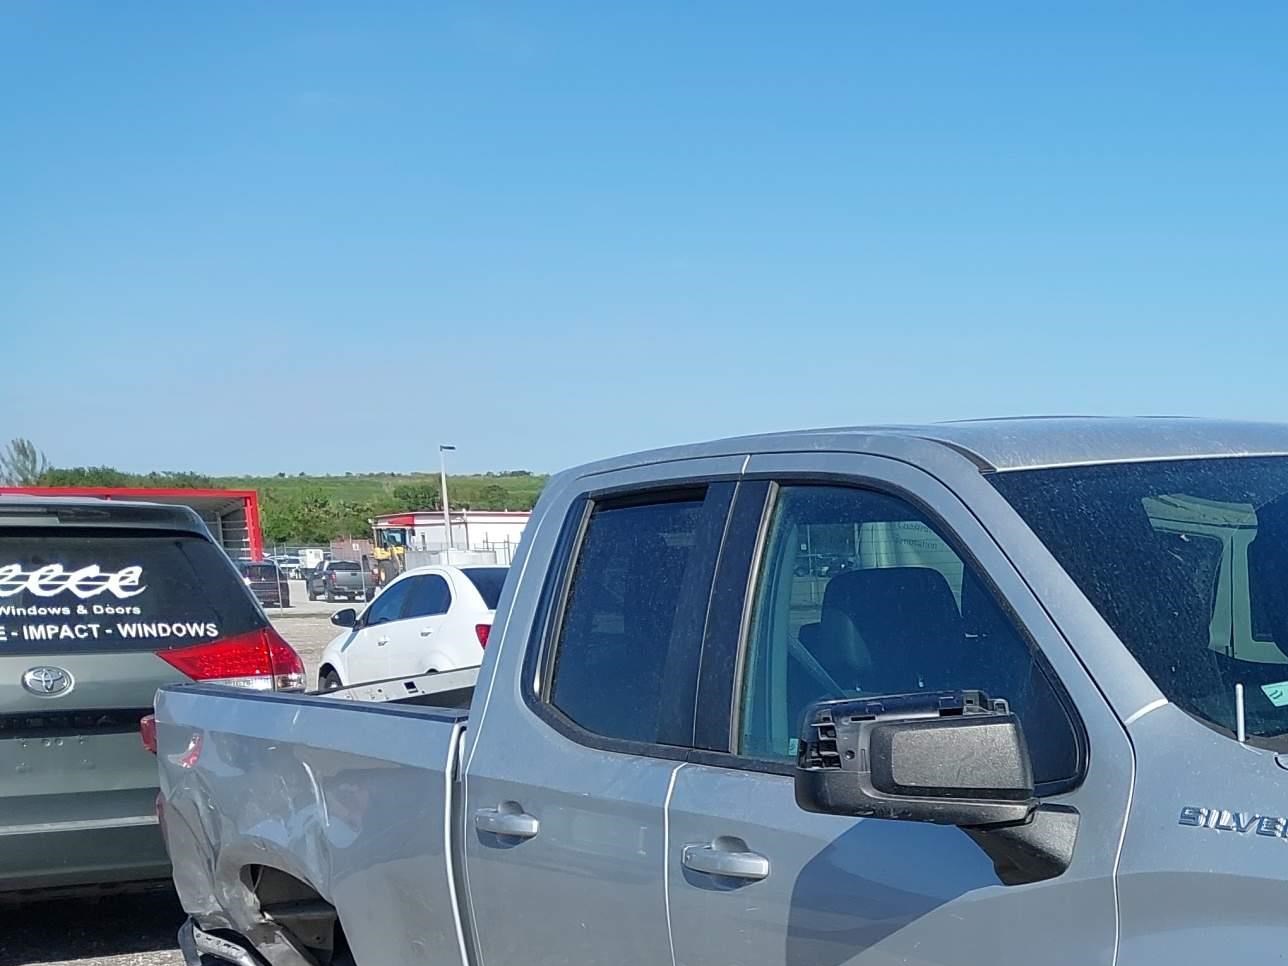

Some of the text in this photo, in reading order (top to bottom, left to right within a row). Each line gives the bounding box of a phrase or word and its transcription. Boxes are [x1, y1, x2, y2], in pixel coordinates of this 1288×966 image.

[76, 604, 88, 615] &
[92, 604, 141, 615] Doors
[23, 623, 100, 641] IMPACT
[117, 622, 219, 639] WINDOWS
